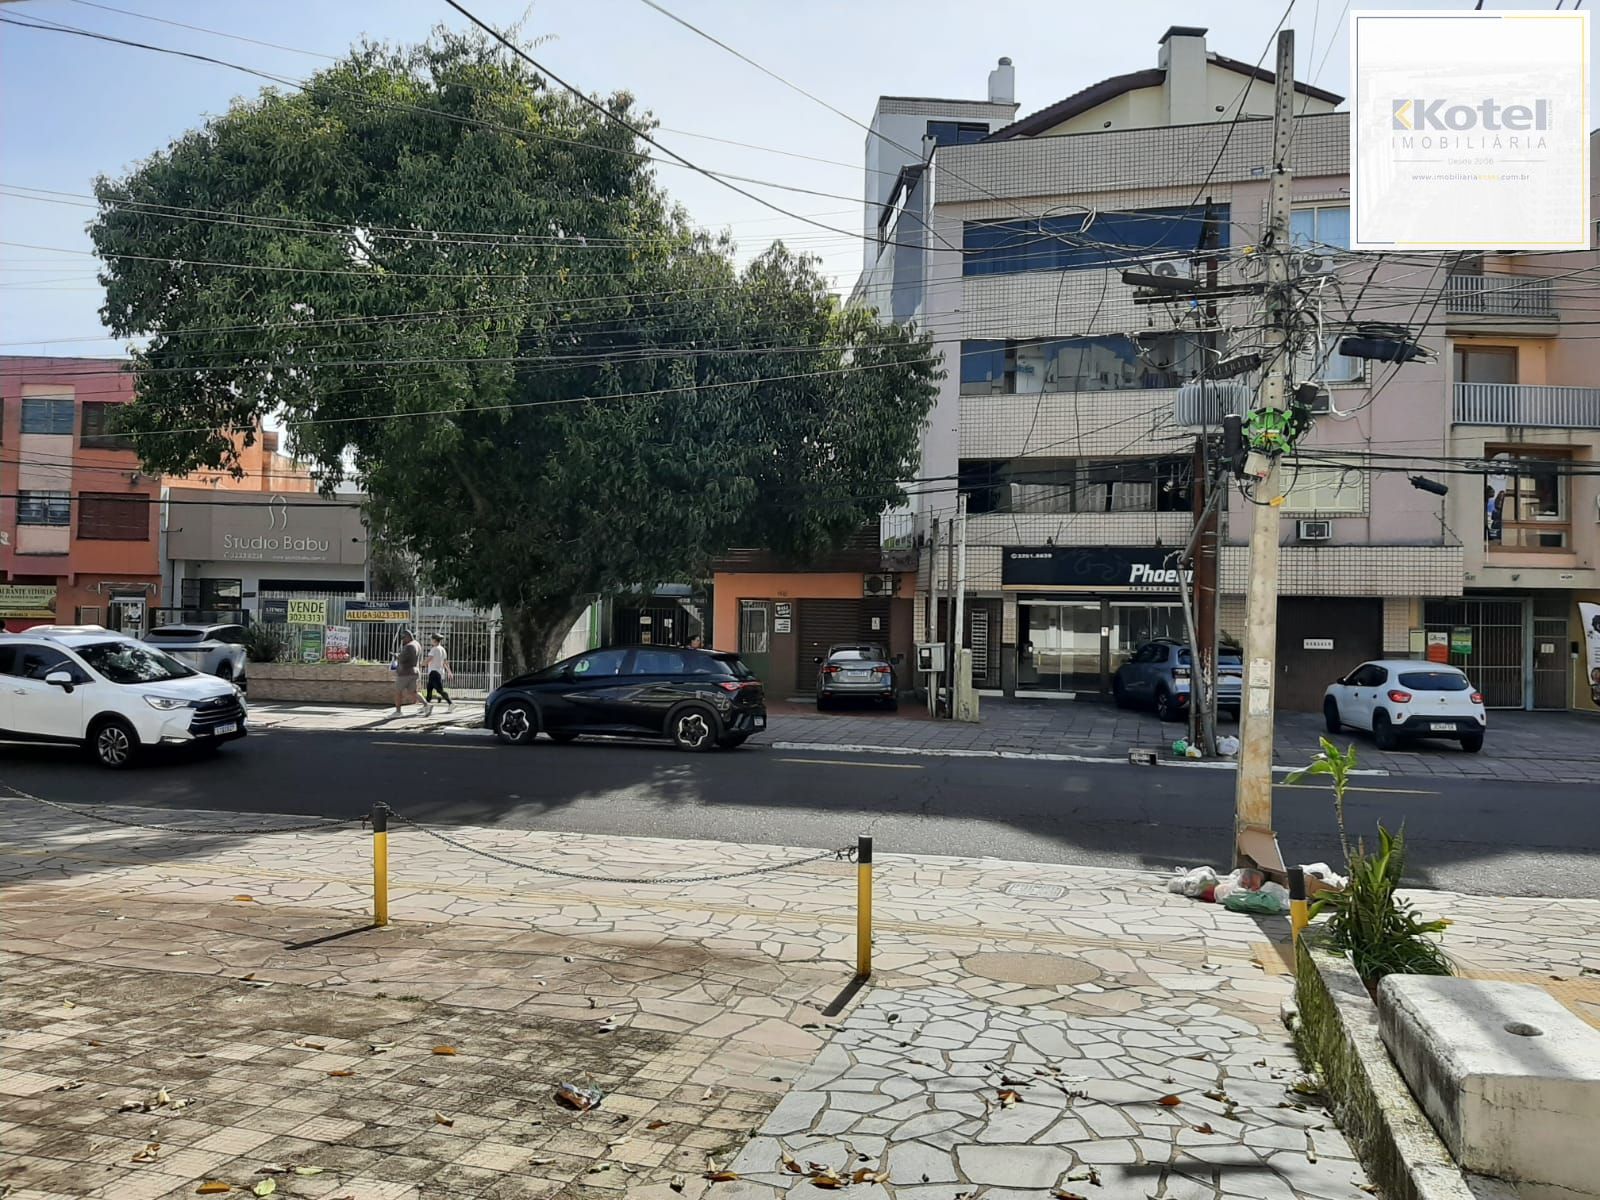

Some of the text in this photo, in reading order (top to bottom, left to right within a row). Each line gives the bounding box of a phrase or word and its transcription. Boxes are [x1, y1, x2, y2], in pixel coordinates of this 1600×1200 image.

[224, 534, 329, 551] Studio Babu
[290, 601, 324, 613] VENDE
[347, 611, 371, 619] ALUGA
